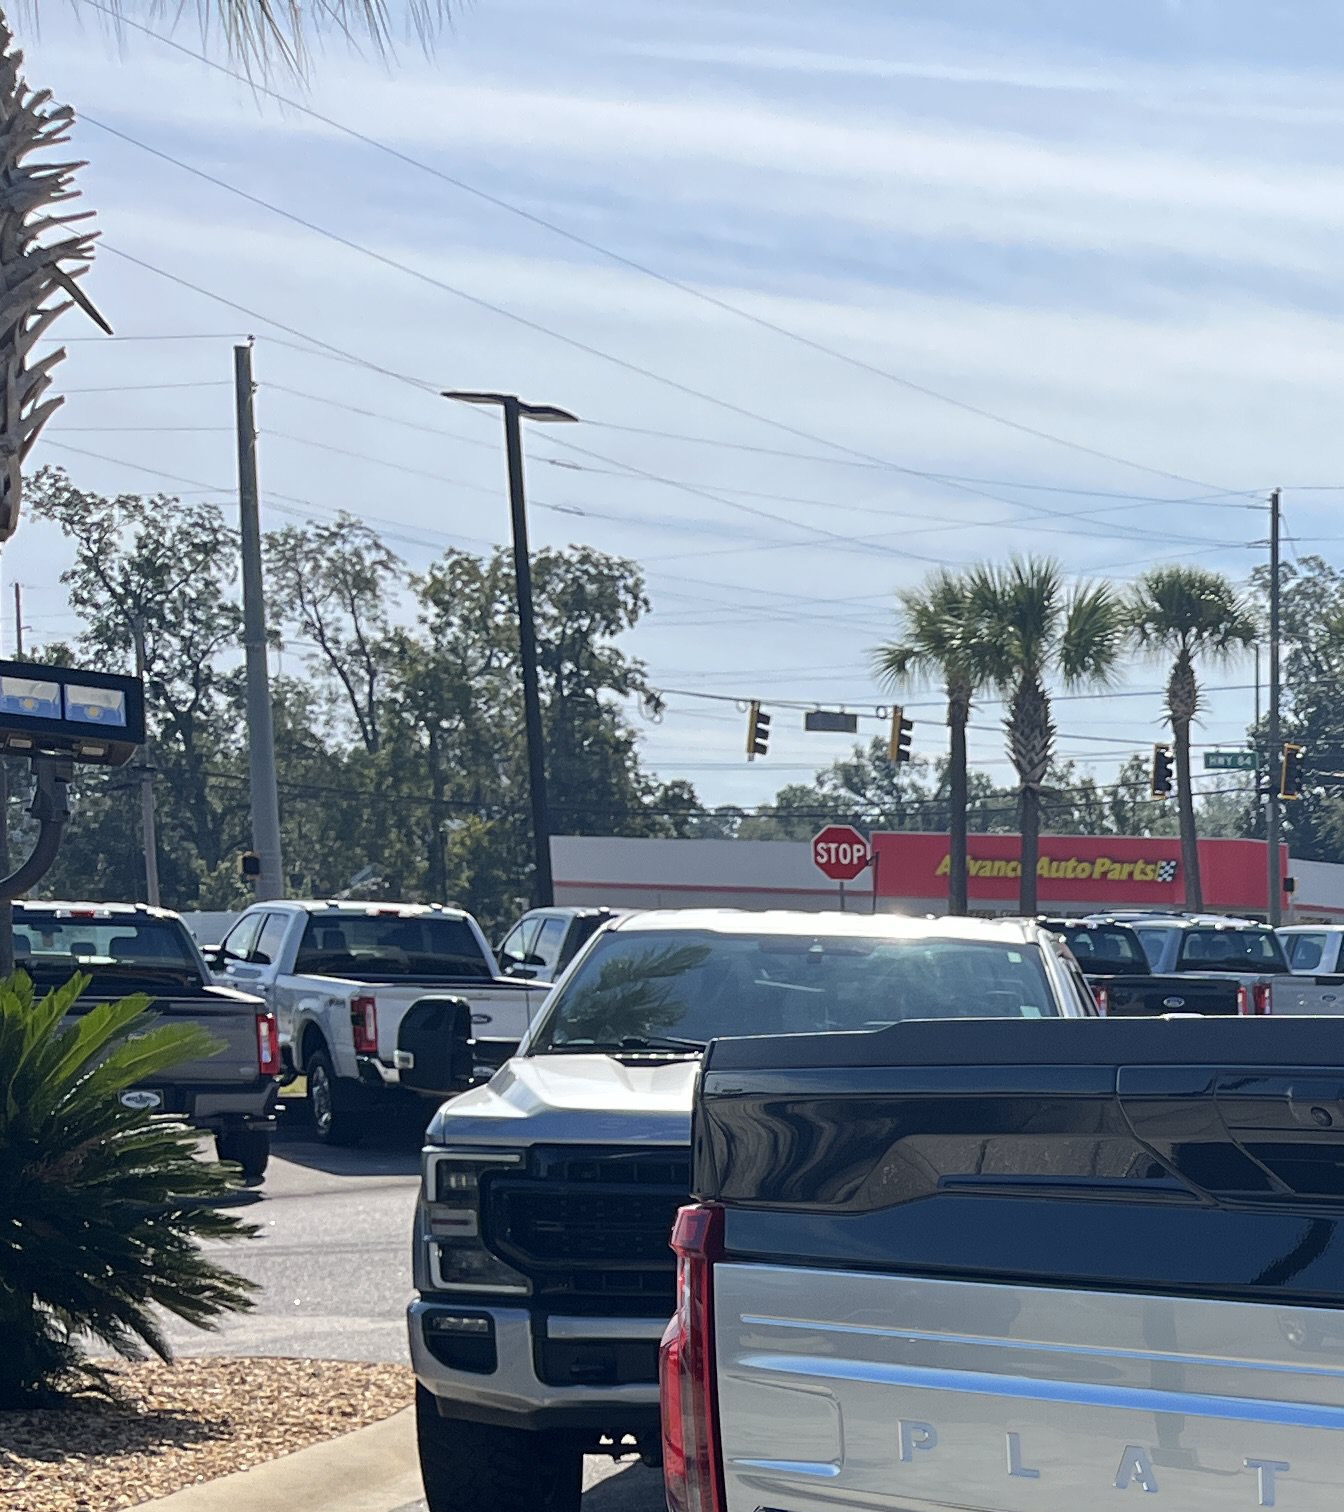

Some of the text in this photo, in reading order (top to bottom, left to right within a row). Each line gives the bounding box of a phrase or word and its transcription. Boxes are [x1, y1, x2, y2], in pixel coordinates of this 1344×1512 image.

[816, 842, 865, 865] STOP
[934, 854, 1157, 881] Avanc Auto Parts
